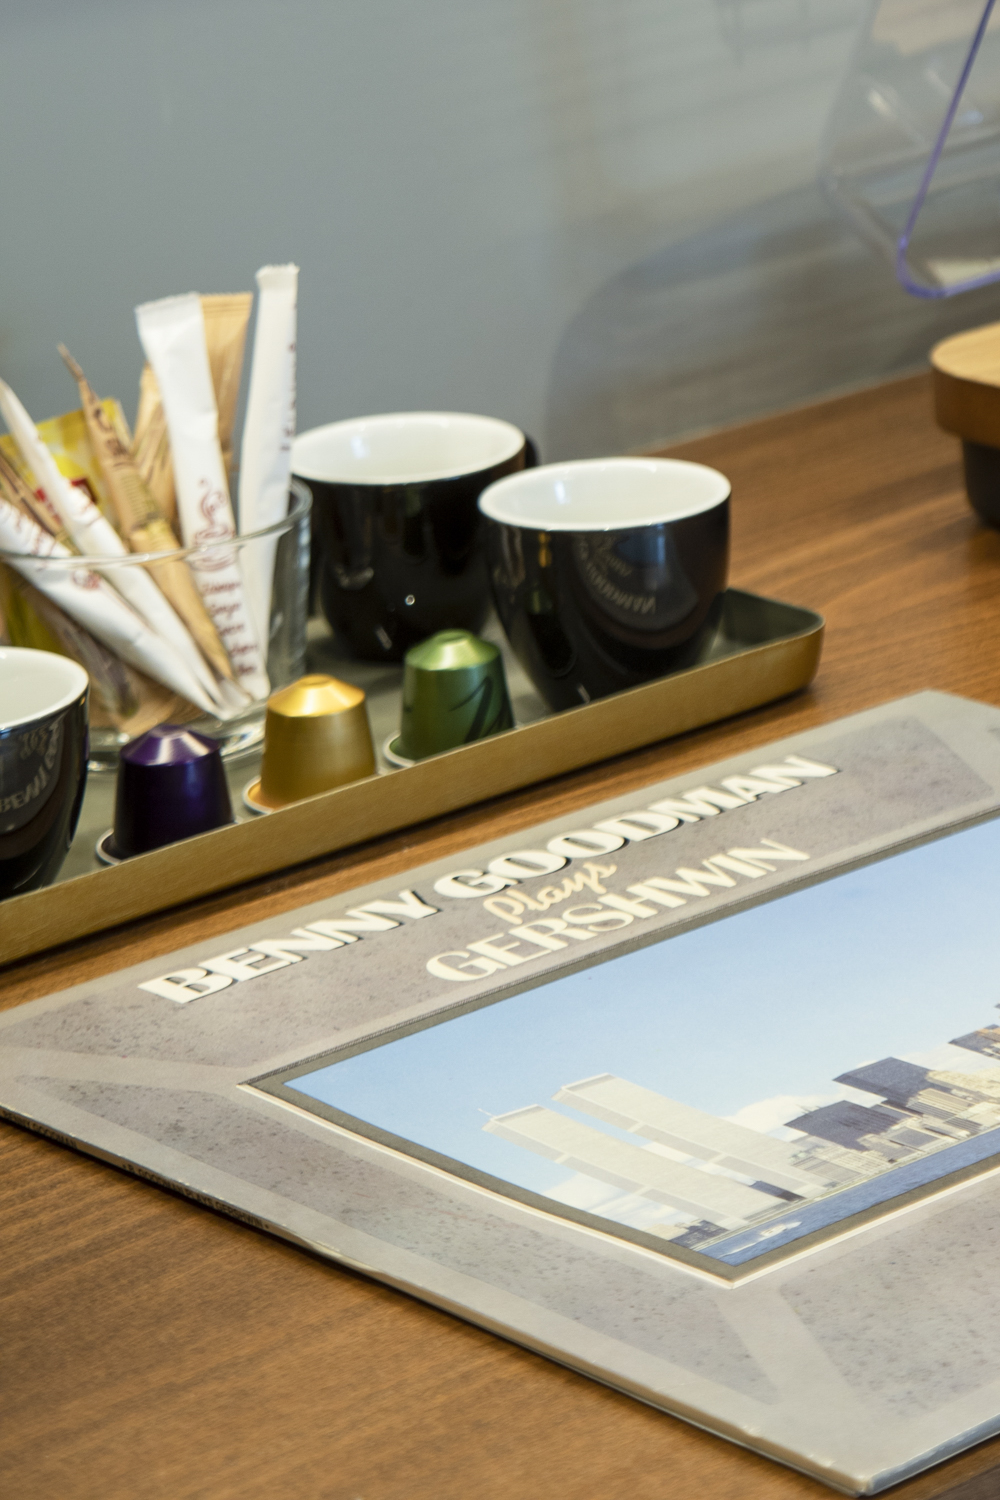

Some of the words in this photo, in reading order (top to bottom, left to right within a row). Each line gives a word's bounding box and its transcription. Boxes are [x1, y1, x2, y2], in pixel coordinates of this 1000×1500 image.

[137, 889, 440, 1005] BENNY
[433, 755, 840, 899] GOODMAN
[425, 838, 811, 982] GERSHWIN
[483, 862, 618, 925] plays
